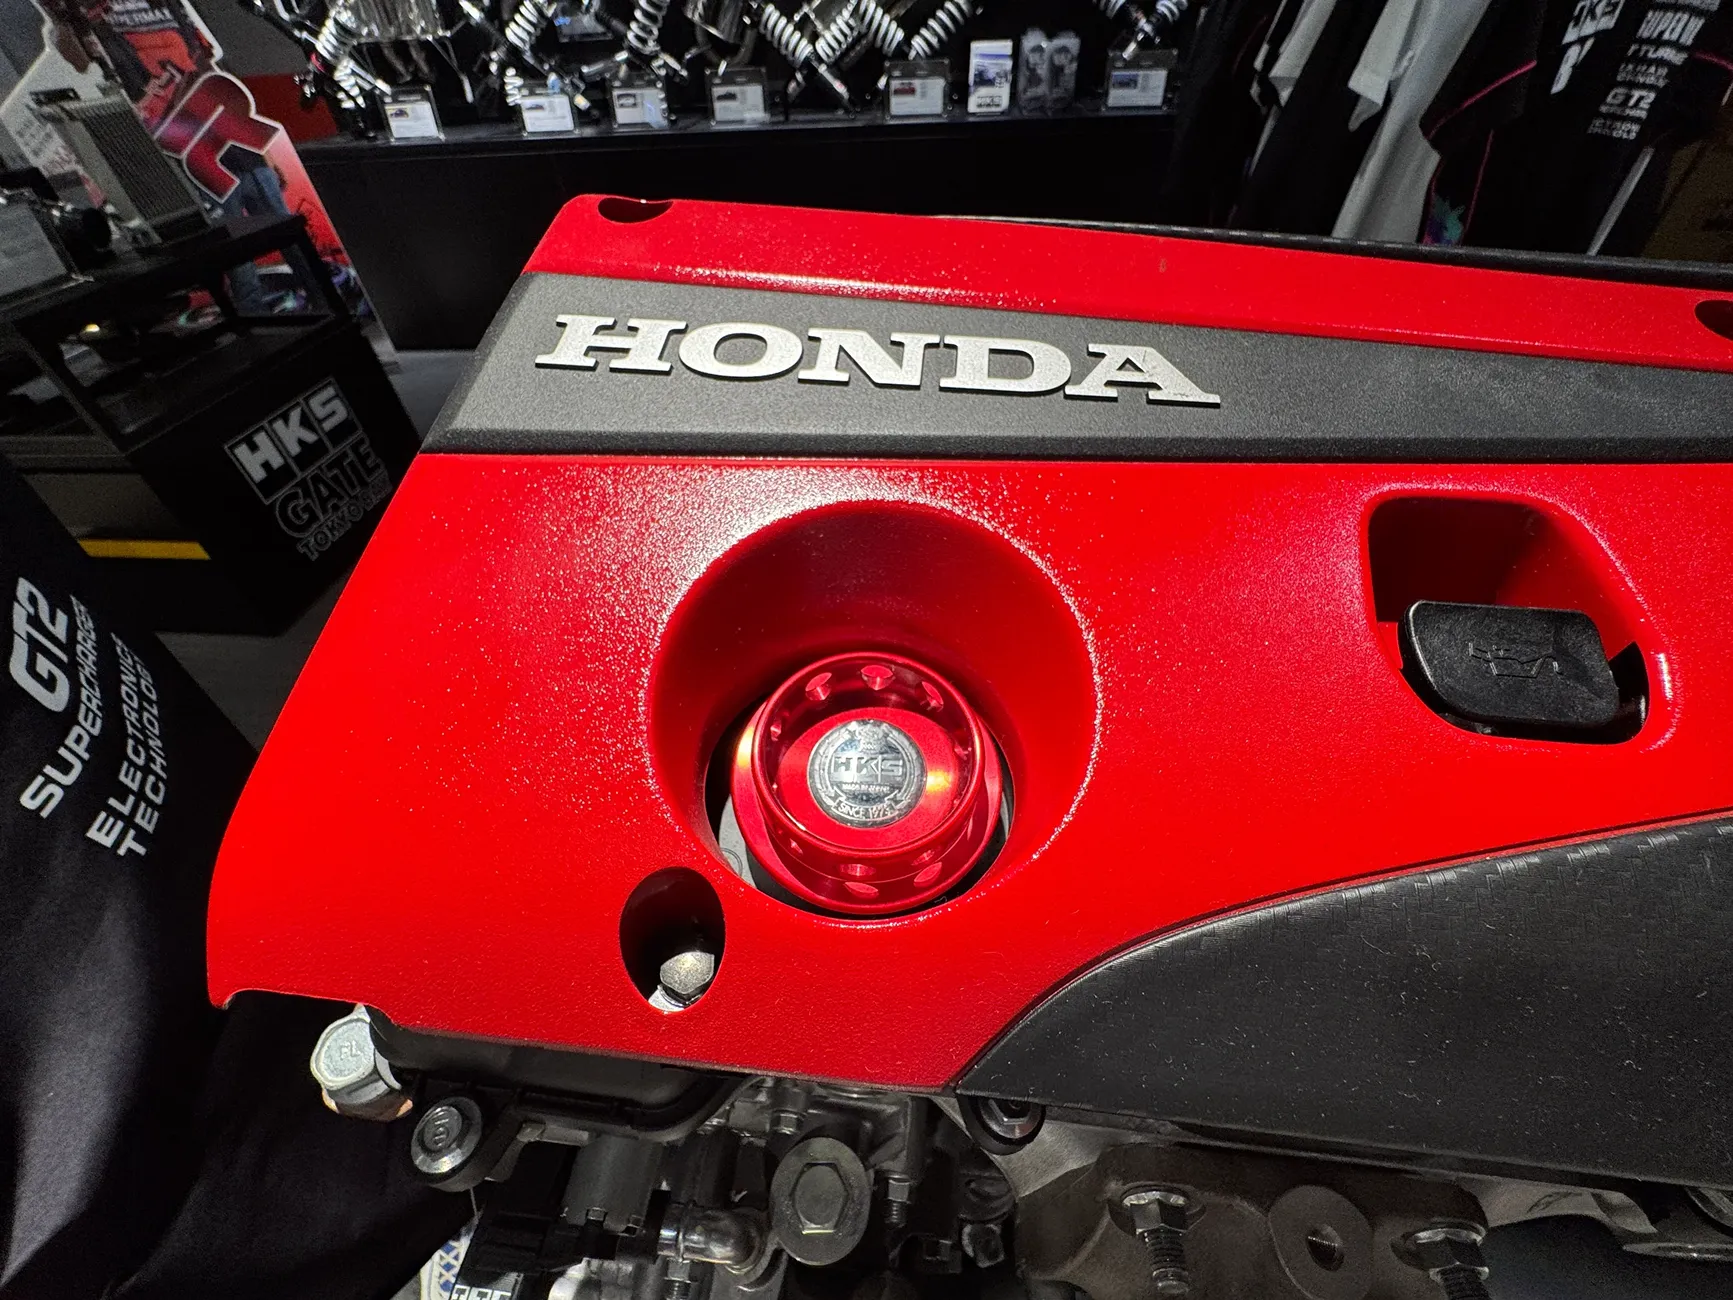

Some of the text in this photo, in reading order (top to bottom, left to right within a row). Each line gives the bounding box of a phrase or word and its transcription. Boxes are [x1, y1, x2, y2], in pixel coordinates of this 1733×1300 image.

[535, 314, 1221, 407] HONDA
[233, 385, 349, 484] HKS
[275, 432, 386, 538] GATE
[9, 576, 70, 713] GT2
[833, 756, 904, 776] HKS
[837, 802, 866, 820] SINCE
